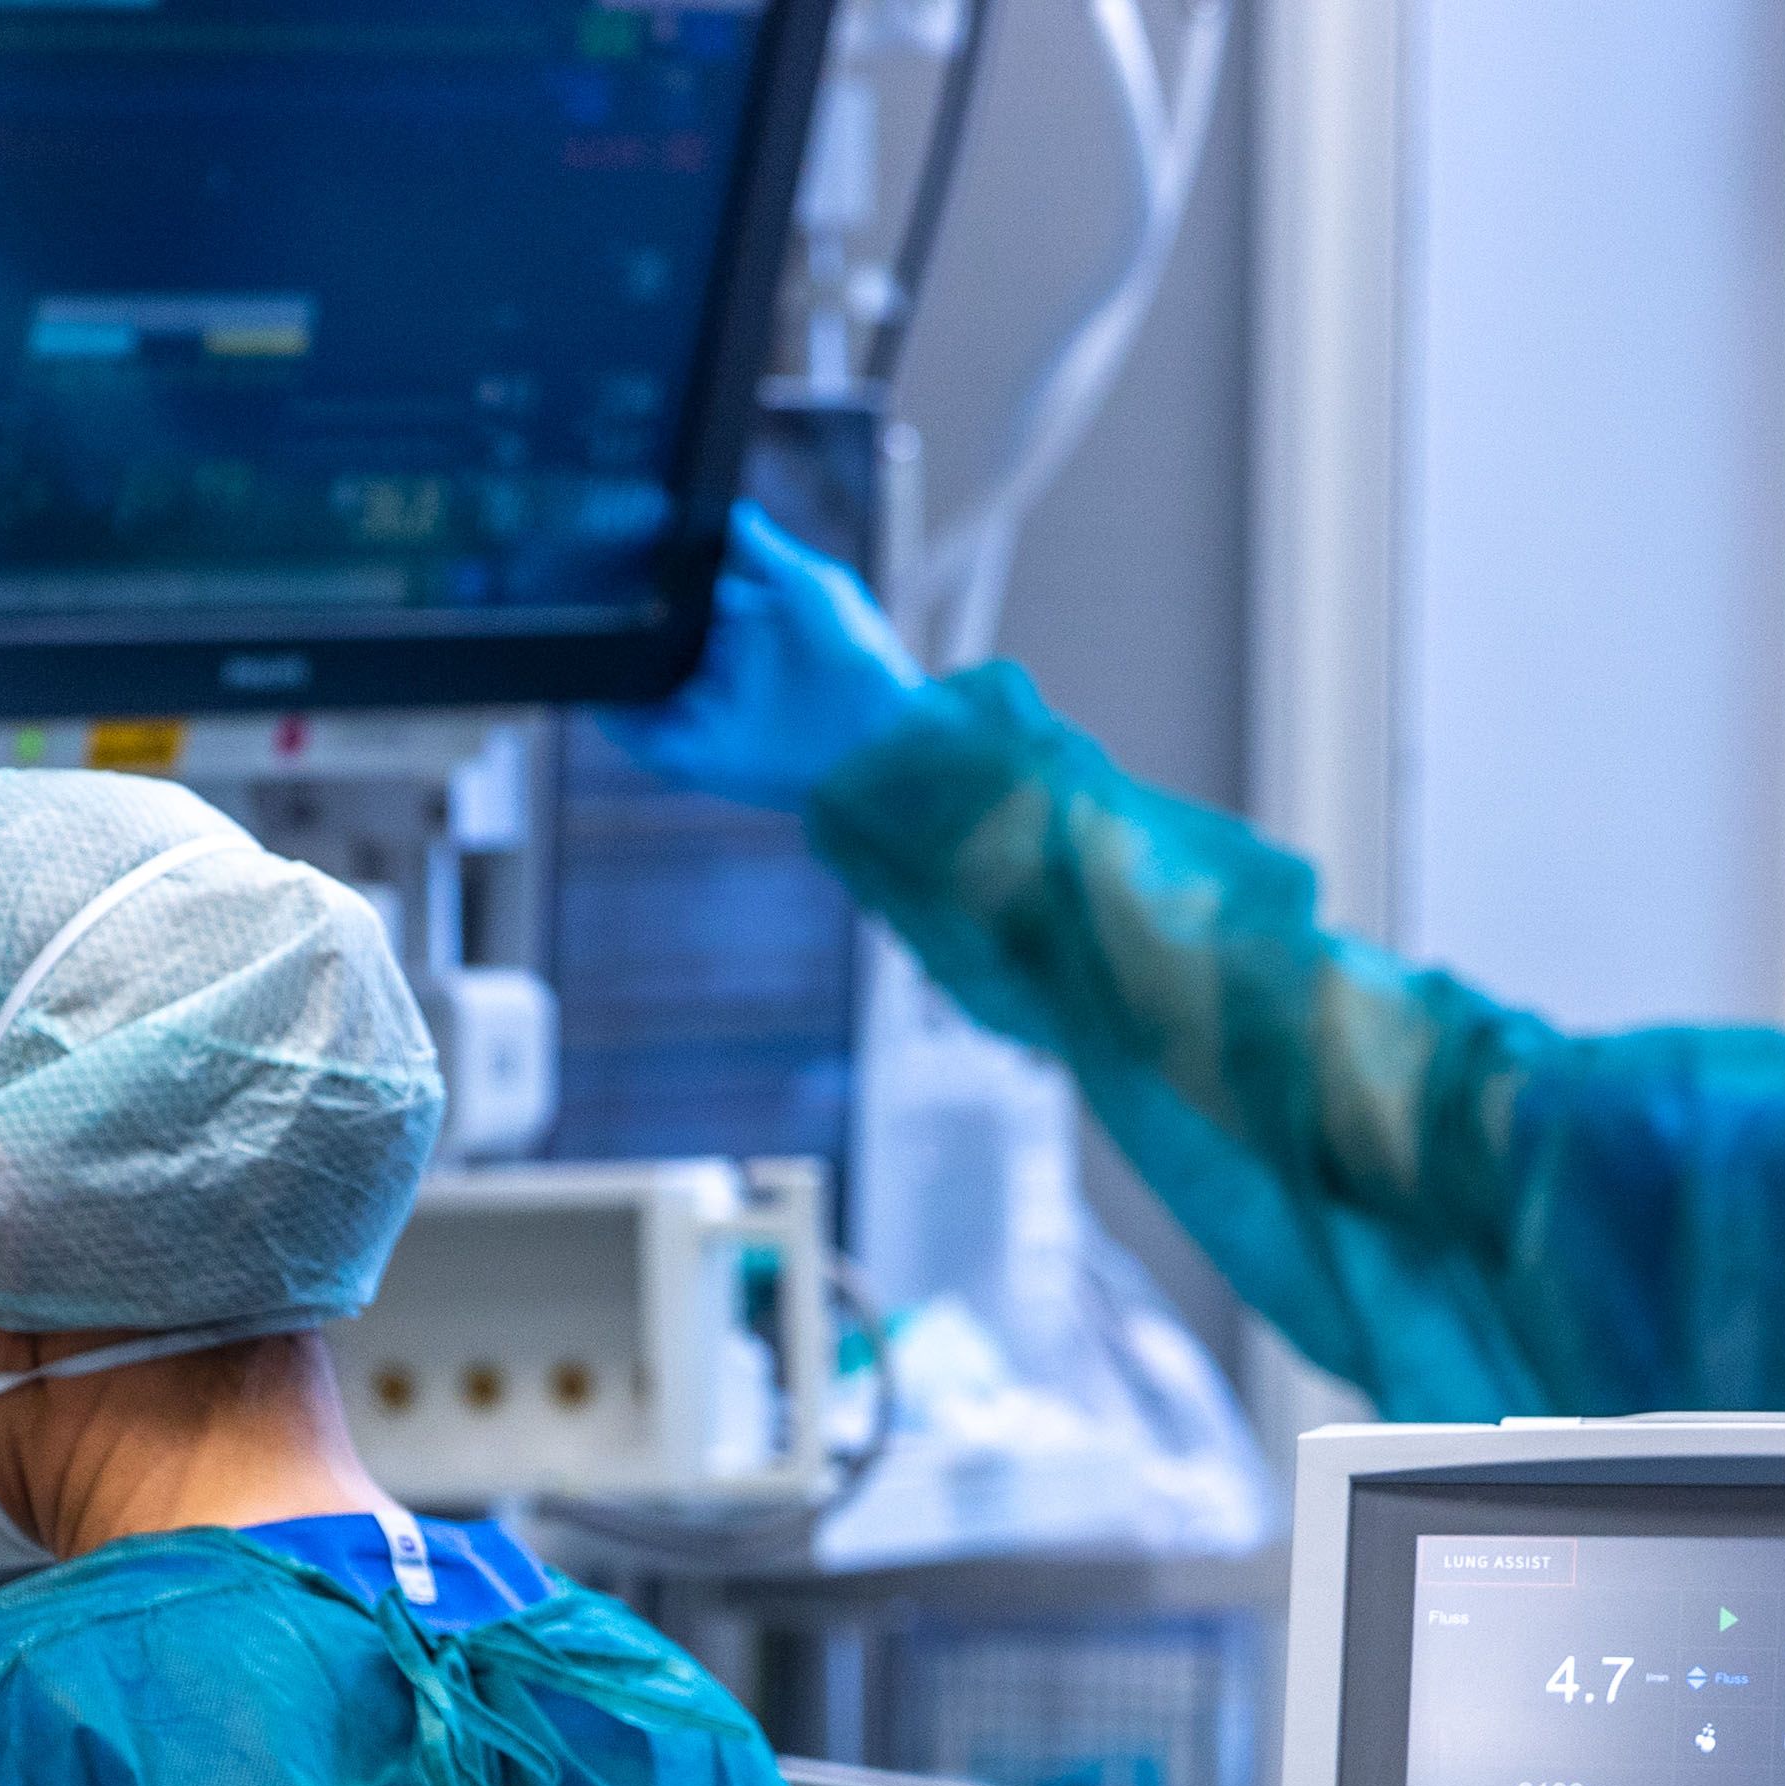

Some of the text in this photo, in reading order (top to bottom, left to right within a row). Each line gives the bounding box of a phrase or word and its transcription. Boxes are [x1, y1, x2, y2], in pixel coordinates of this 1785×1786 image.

[1444, 1555, 1552, 1569] LUNG ASSIST
[1428, 1610, 1470, 1625] Fluss
[1545, 1655, 1635, 1704] 4.7
[1714, 1671, 1750, 1685] Fluss
